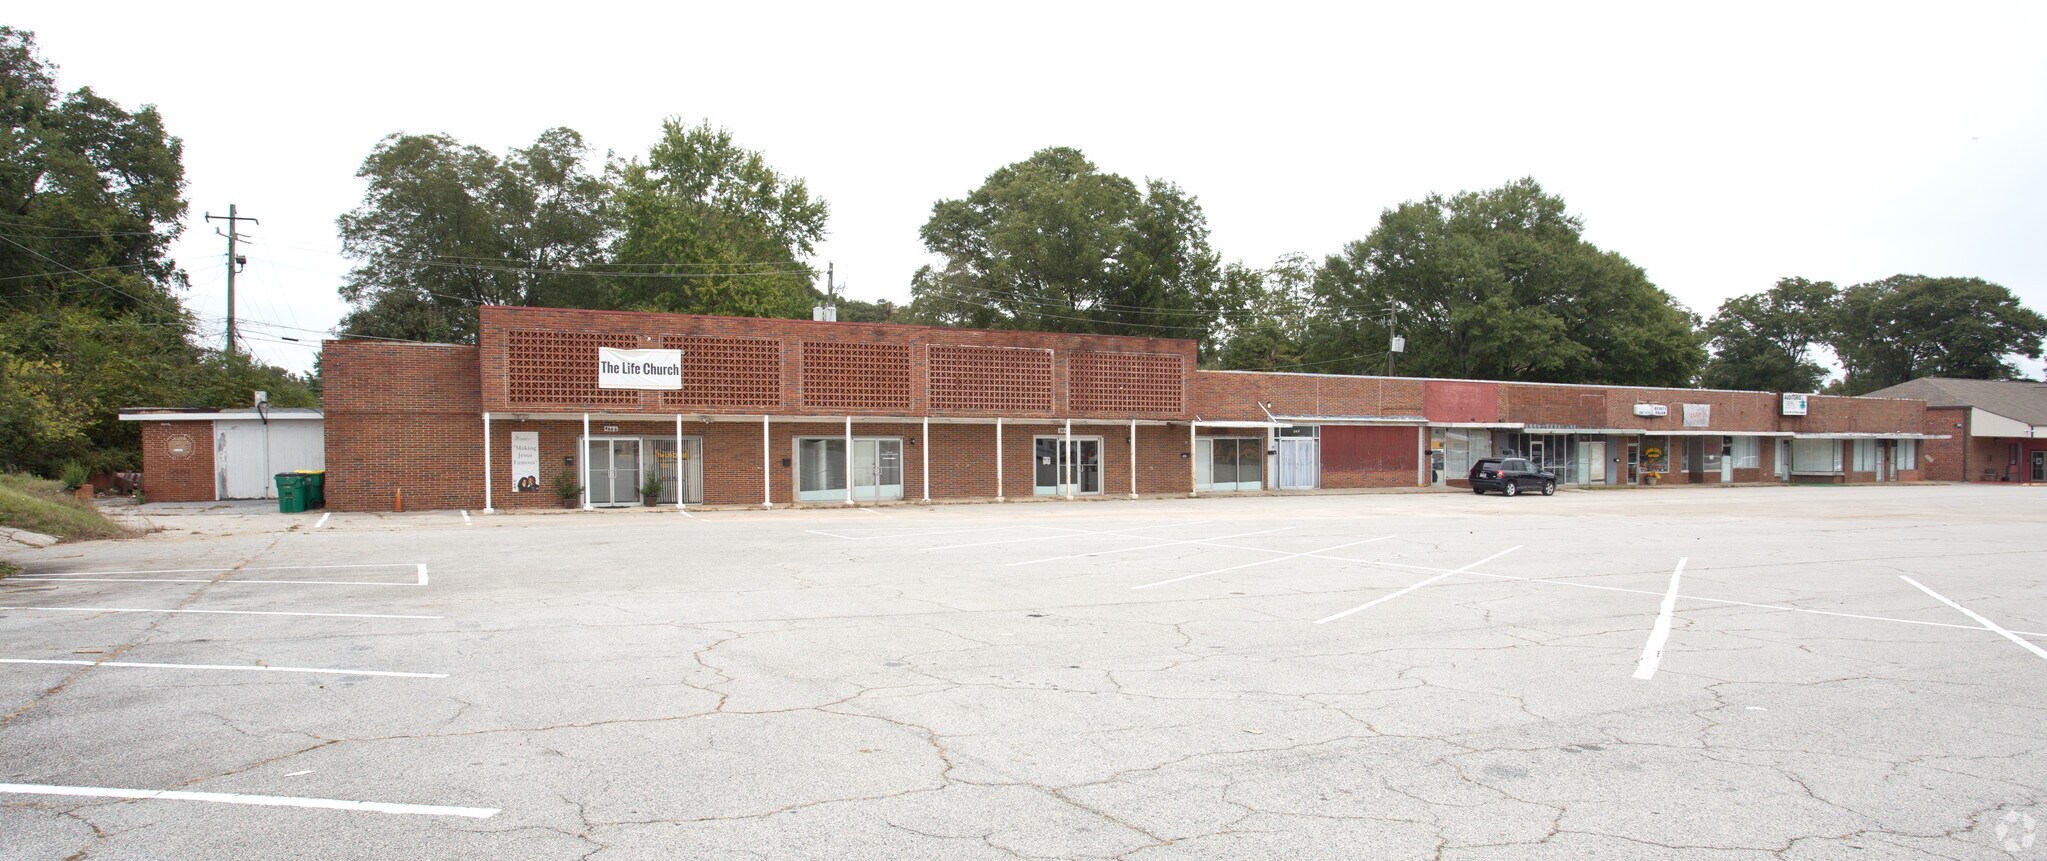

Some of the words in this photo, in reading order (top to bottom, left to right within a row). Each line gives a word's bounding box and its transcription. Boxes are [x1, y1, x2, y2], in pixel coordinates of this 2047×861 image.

[601, 361, 619, 373] The
[622, 362, 640, 374] Life
[643, 362, 679, 375] Church
